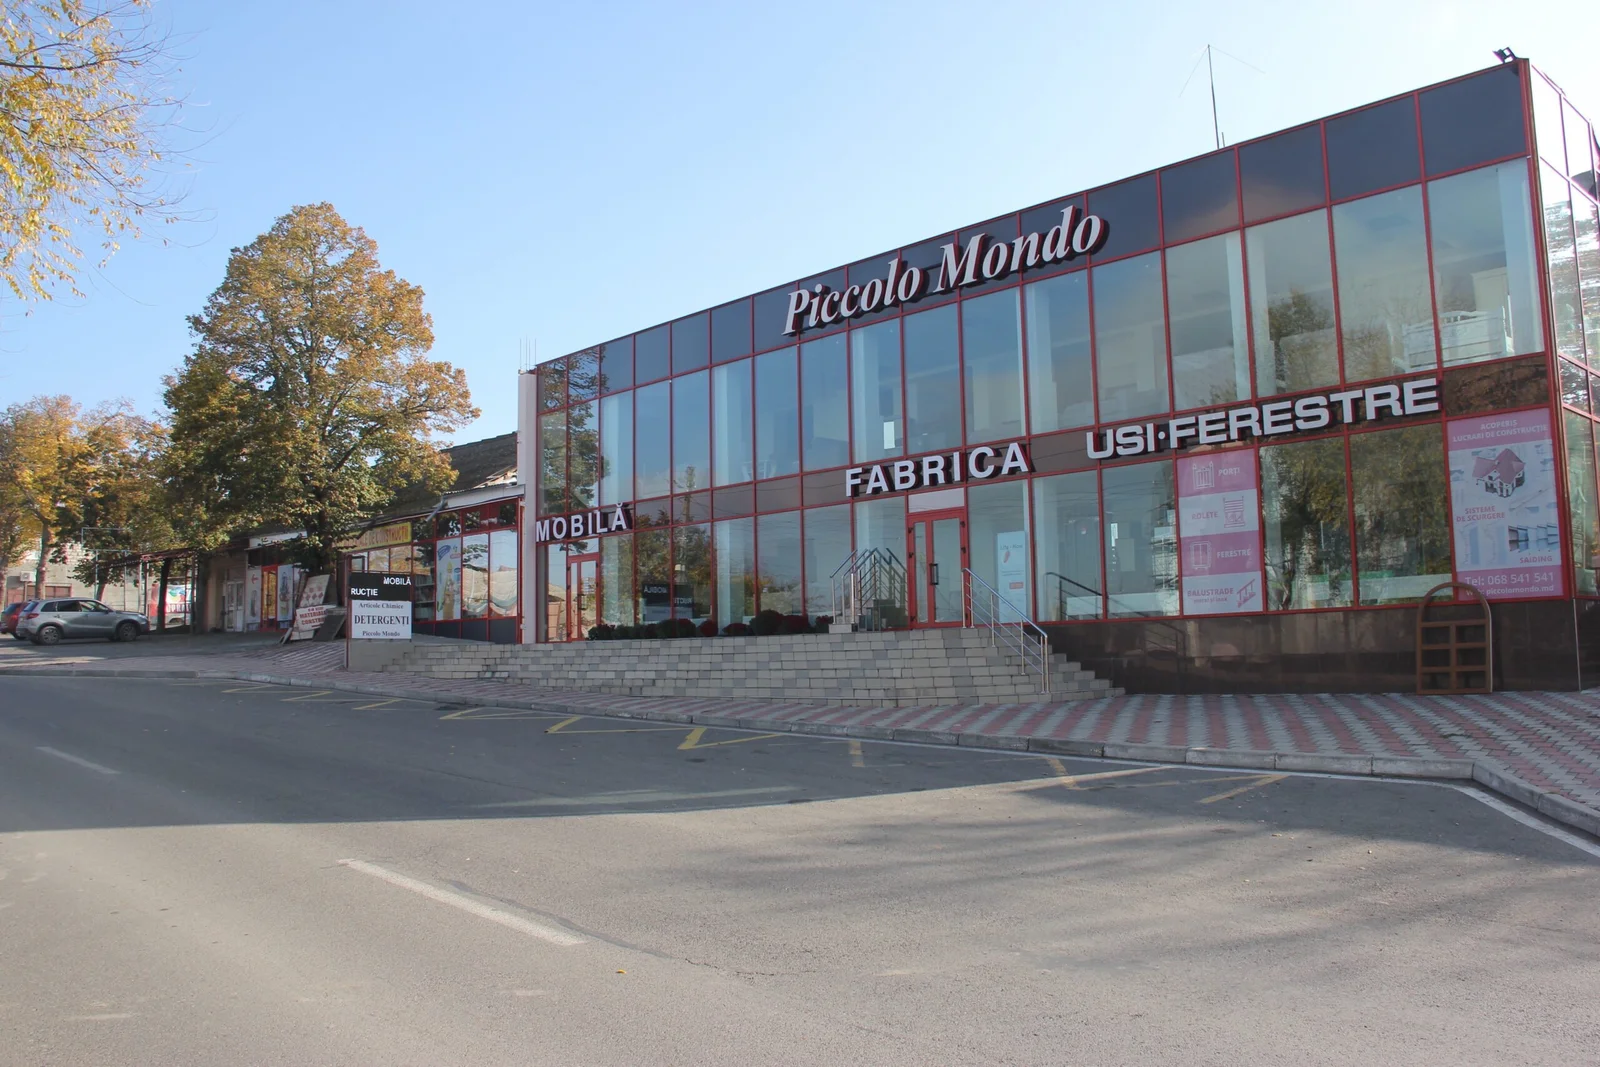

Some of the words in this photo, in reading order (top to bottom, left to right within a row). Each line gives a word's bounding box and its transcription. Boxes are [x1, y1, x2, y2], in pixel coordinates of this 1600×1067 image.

[781, 258, 921, 336] Piccolo
[933, 205, 1102, 293] Mondo
[1453, 433, 1485, 442] LUCRARI
[845, 442, 1029, 497] FABRICA
[1464, 506, 1496, 514] SISTEME
[1191, 511, 1218, 520] ROLETE
[1467, 512, 1505, 521] SCURGERE
[536, 502, 627, 542] MOBILĂ
[1217, 548, 1251, 559] FERESTRE
[1519, 555, 1552, 563] SAIDING
[383, 576, 411, 586] MOBILĂ
[1465, 576, 1485, 586] Tel:
[1488, 575, 1507, 585] 068
[1510, 573, 1530, 583] 541
[1534, 572, 1554, 582] 541
[1187, 588, 1234, 597] BALUSTRADE
[1487, 585, 1554, 597] piccolomondo.md
